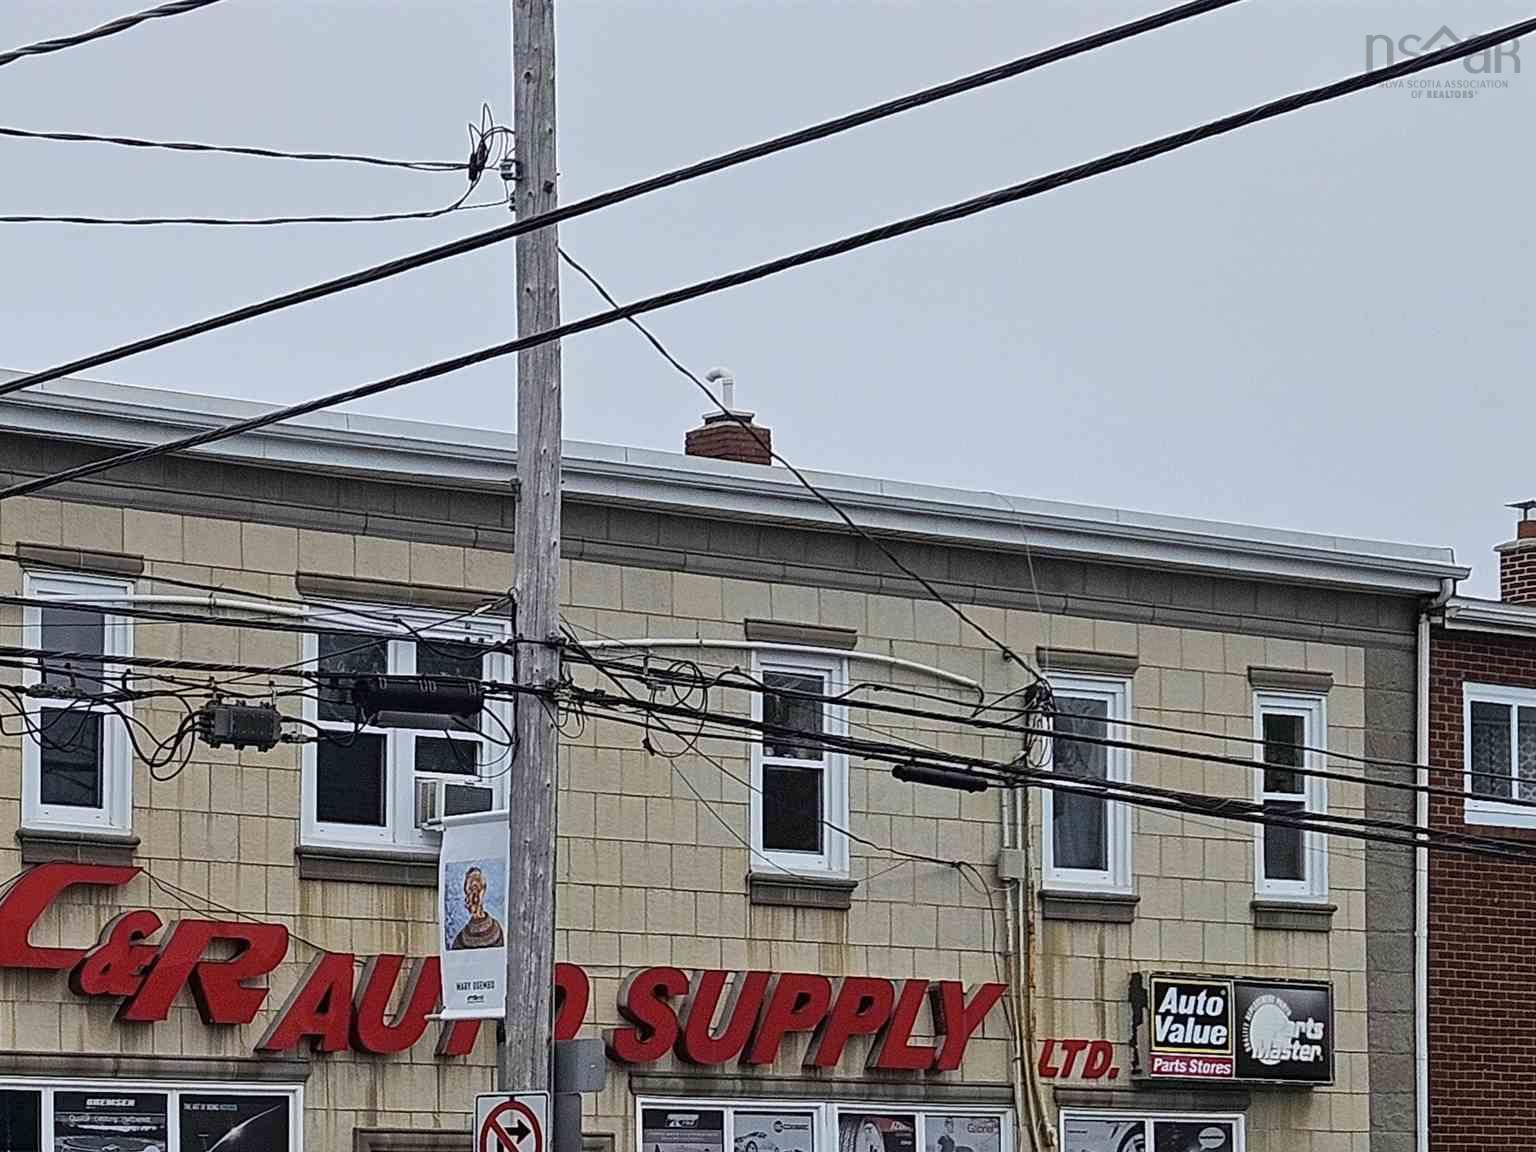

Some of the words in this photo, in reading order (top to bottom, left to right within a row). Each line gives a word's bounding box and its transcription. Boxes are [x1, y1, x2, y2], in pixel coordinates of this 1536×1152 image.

[1158, 987, 1224, 1016] Auto
[604, 966, 1008, 1072] SUPPLY
[1155, 1015, 1228, 1045] Value
[1038, 1038, 1120, 1080] LTD.
[1153, 1057, 1187, 1074] Parts
[1189, 1060, 1232, 1075] Stores
